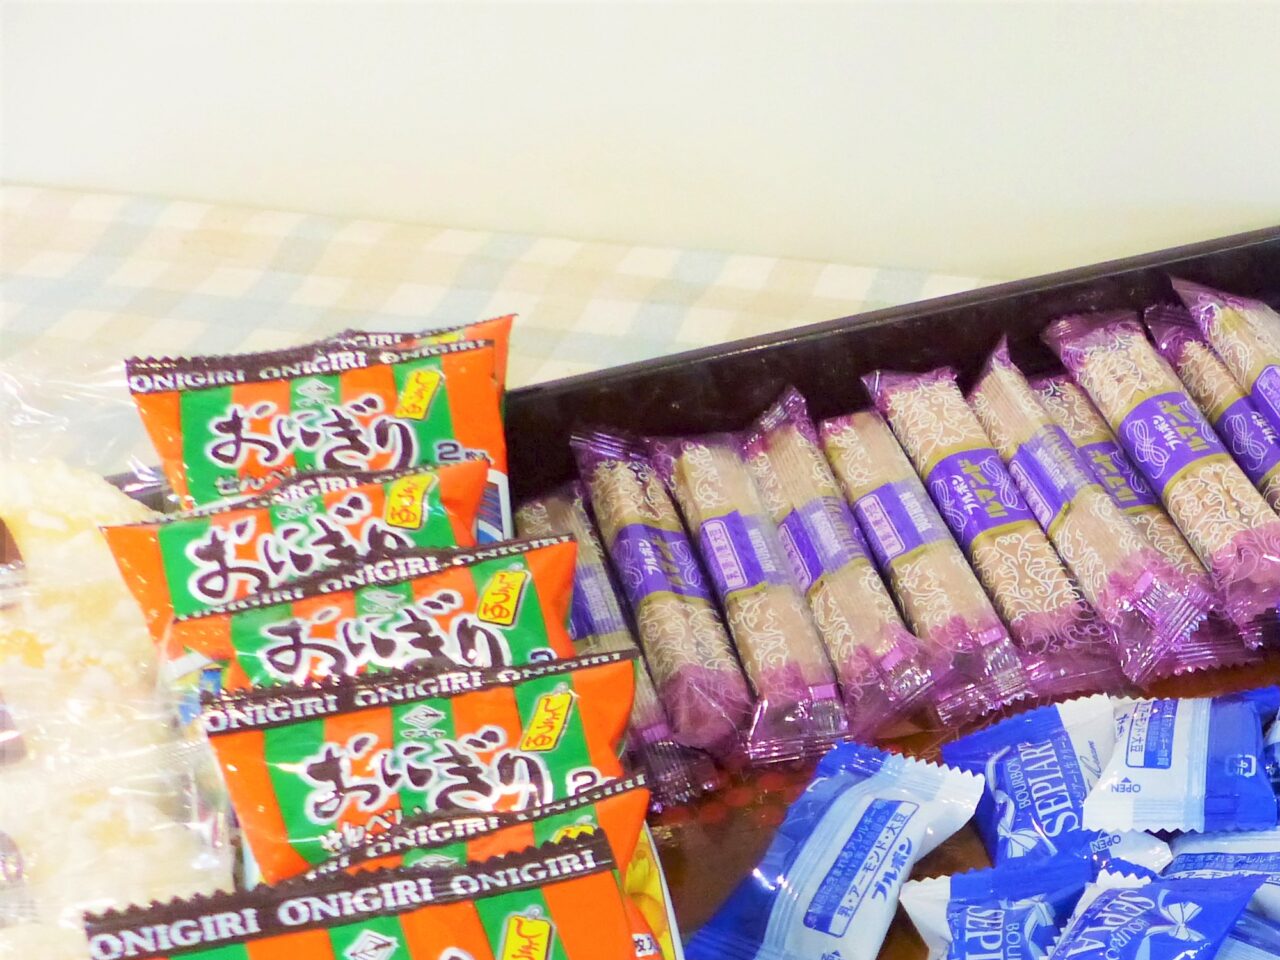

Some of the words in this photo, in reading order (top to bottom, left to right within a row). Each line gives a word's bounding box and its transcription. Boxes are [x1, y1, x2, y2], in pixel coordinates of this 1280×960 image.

[130, 369, 246, 393] ONIGIRI
[259, 351, 367, 379] ONIGIRI
[205, 394, 419, 471] おにぎり
[1152, 413, 1184, 452] ブルボン
[1156, 400, 1211, 452] ルマンド
[950, 473, 982, 517] ブルボン
[957, 457, 1009, 518] ルマンド
[1088, 449, 1138, 502] ルマンド
[319, 557, 439, 592] ONIGIRI
[206, 695, 338, 733] ONIGIRI
[355, 672, 482, 706] ONIGIRI
[303, 726, 552, 824] おにぎり
[1016, 738, 1081, 838] SEPIAR
[1111, 783, 1141, 794] OPEN
[366, 816, 501, 858] ONIGIRI
[1092, 834, 1122, 853] OPEN
[278, 878, 435, 926] ONIGIRI
[452, 850, 597, 899] ONIGIRI
[871, 836, 914, 902] ブルボン
